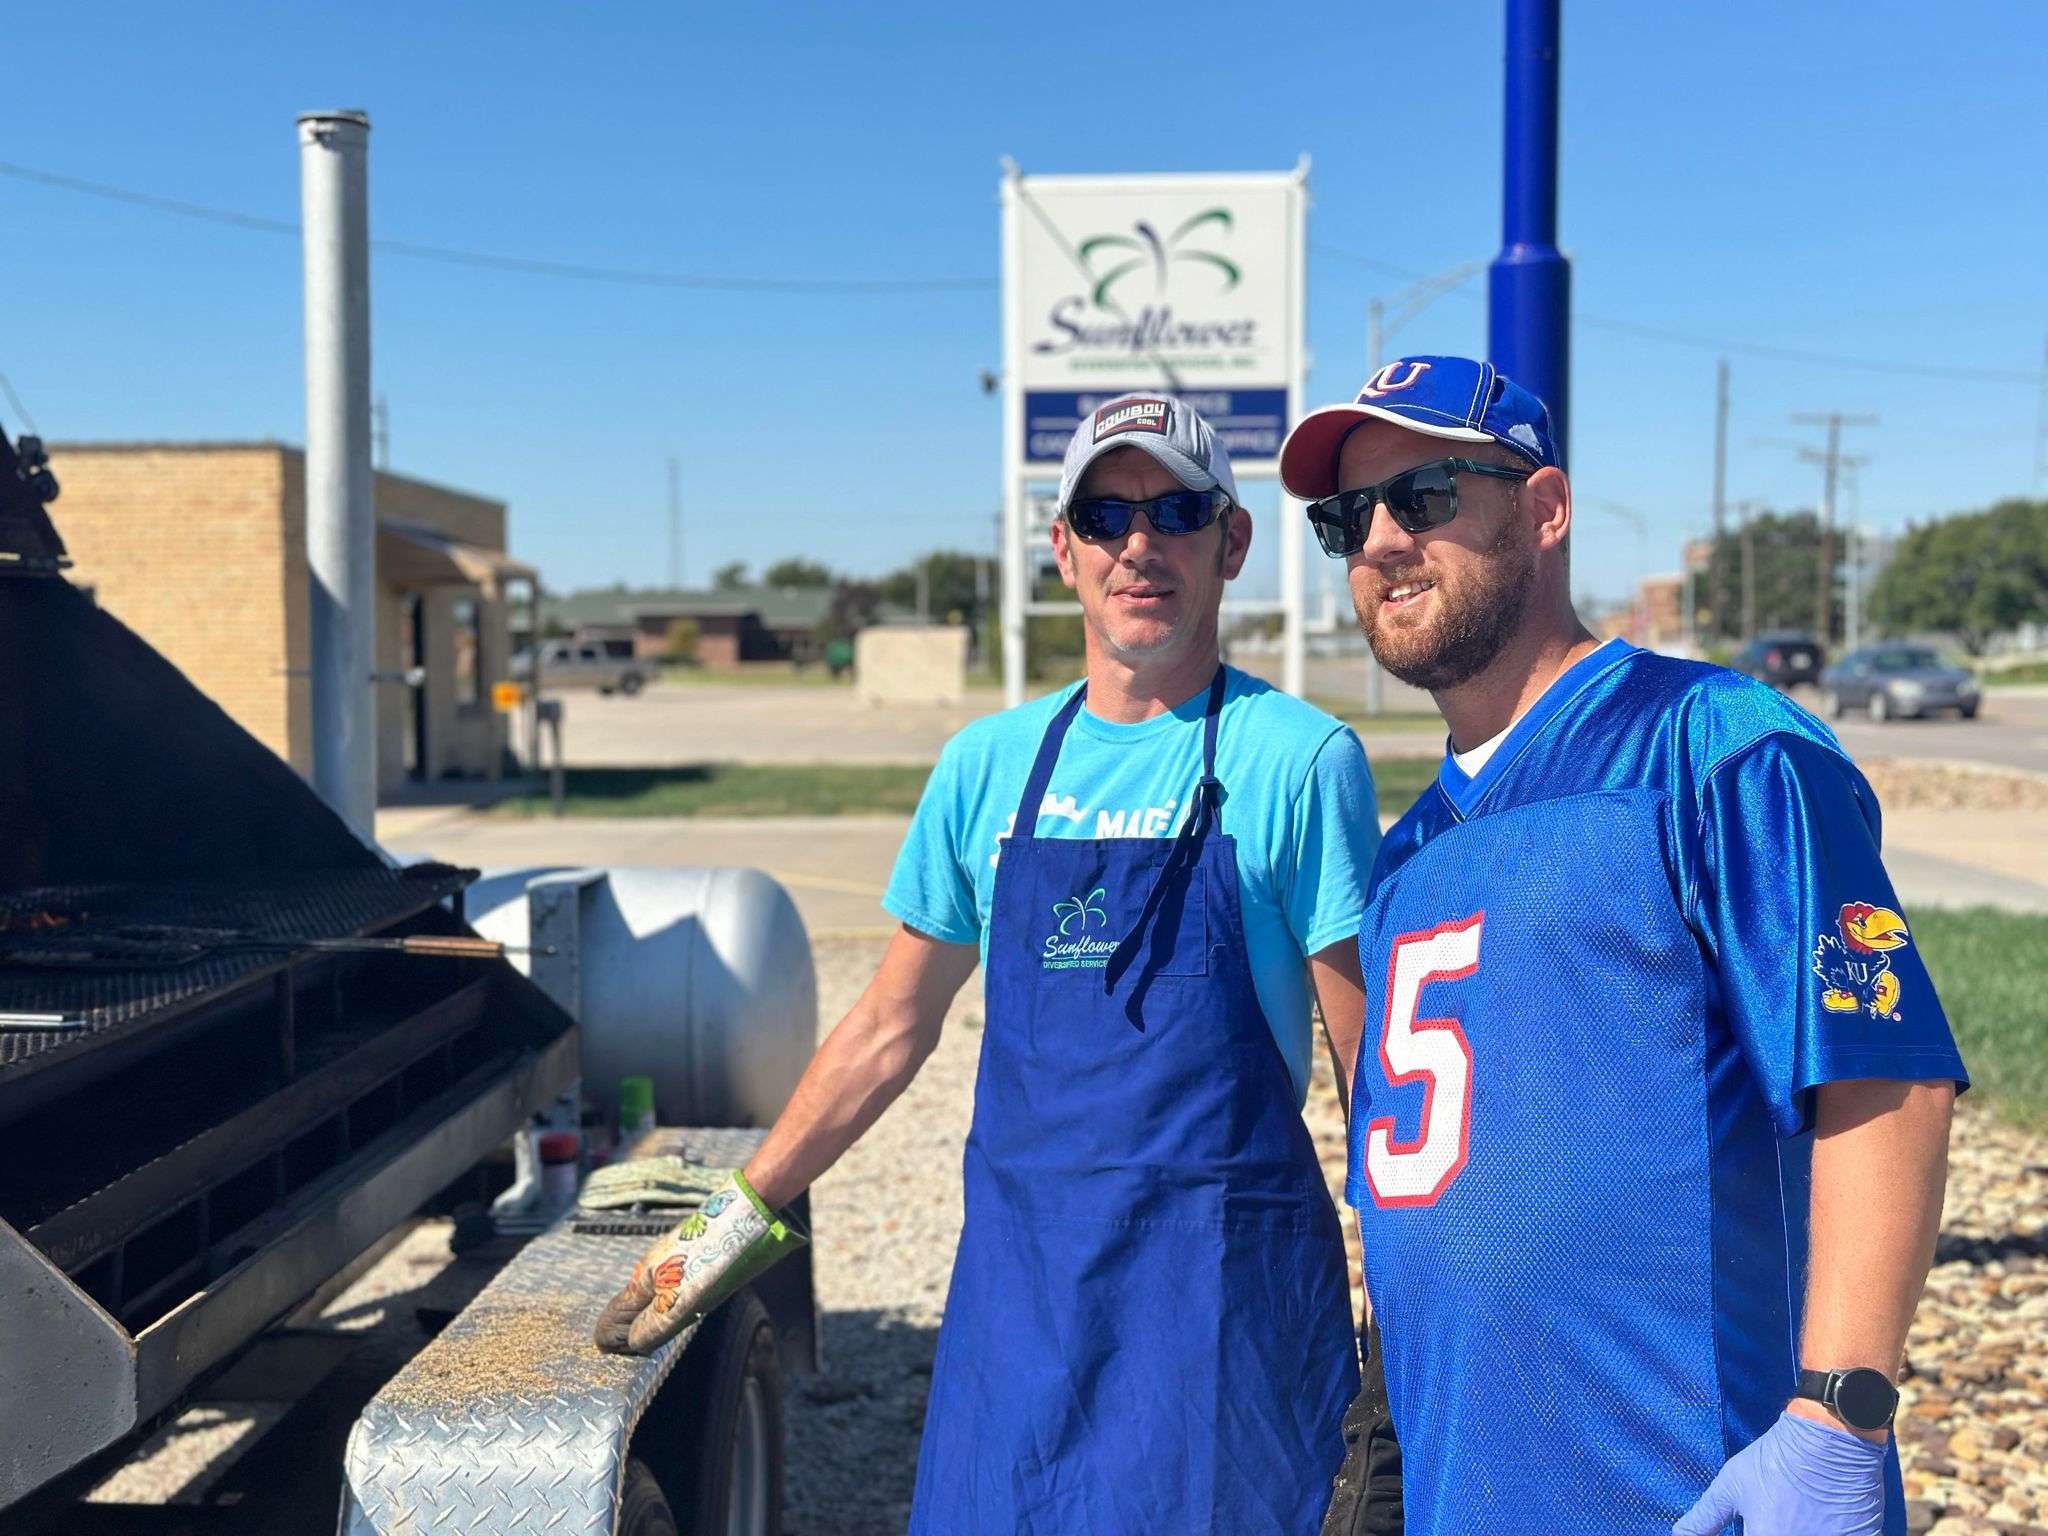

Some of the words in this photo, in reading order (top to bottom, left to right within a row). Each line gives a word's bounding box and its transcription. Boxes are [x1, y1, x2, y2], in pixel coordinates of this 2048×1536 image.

[1032, 298, 1255, 352] Sunflower
[1095, 403, 1166, 438] COWBOY
[1136, 418, 1157, 426] COOL
[1042, 935, 1121, 959] Sunflower
[1043, 960, 1080, 970] DIVERSIFIED
[1845, 961, 1868, 985] KU
[1364, 909, 1485, 1209] 5
